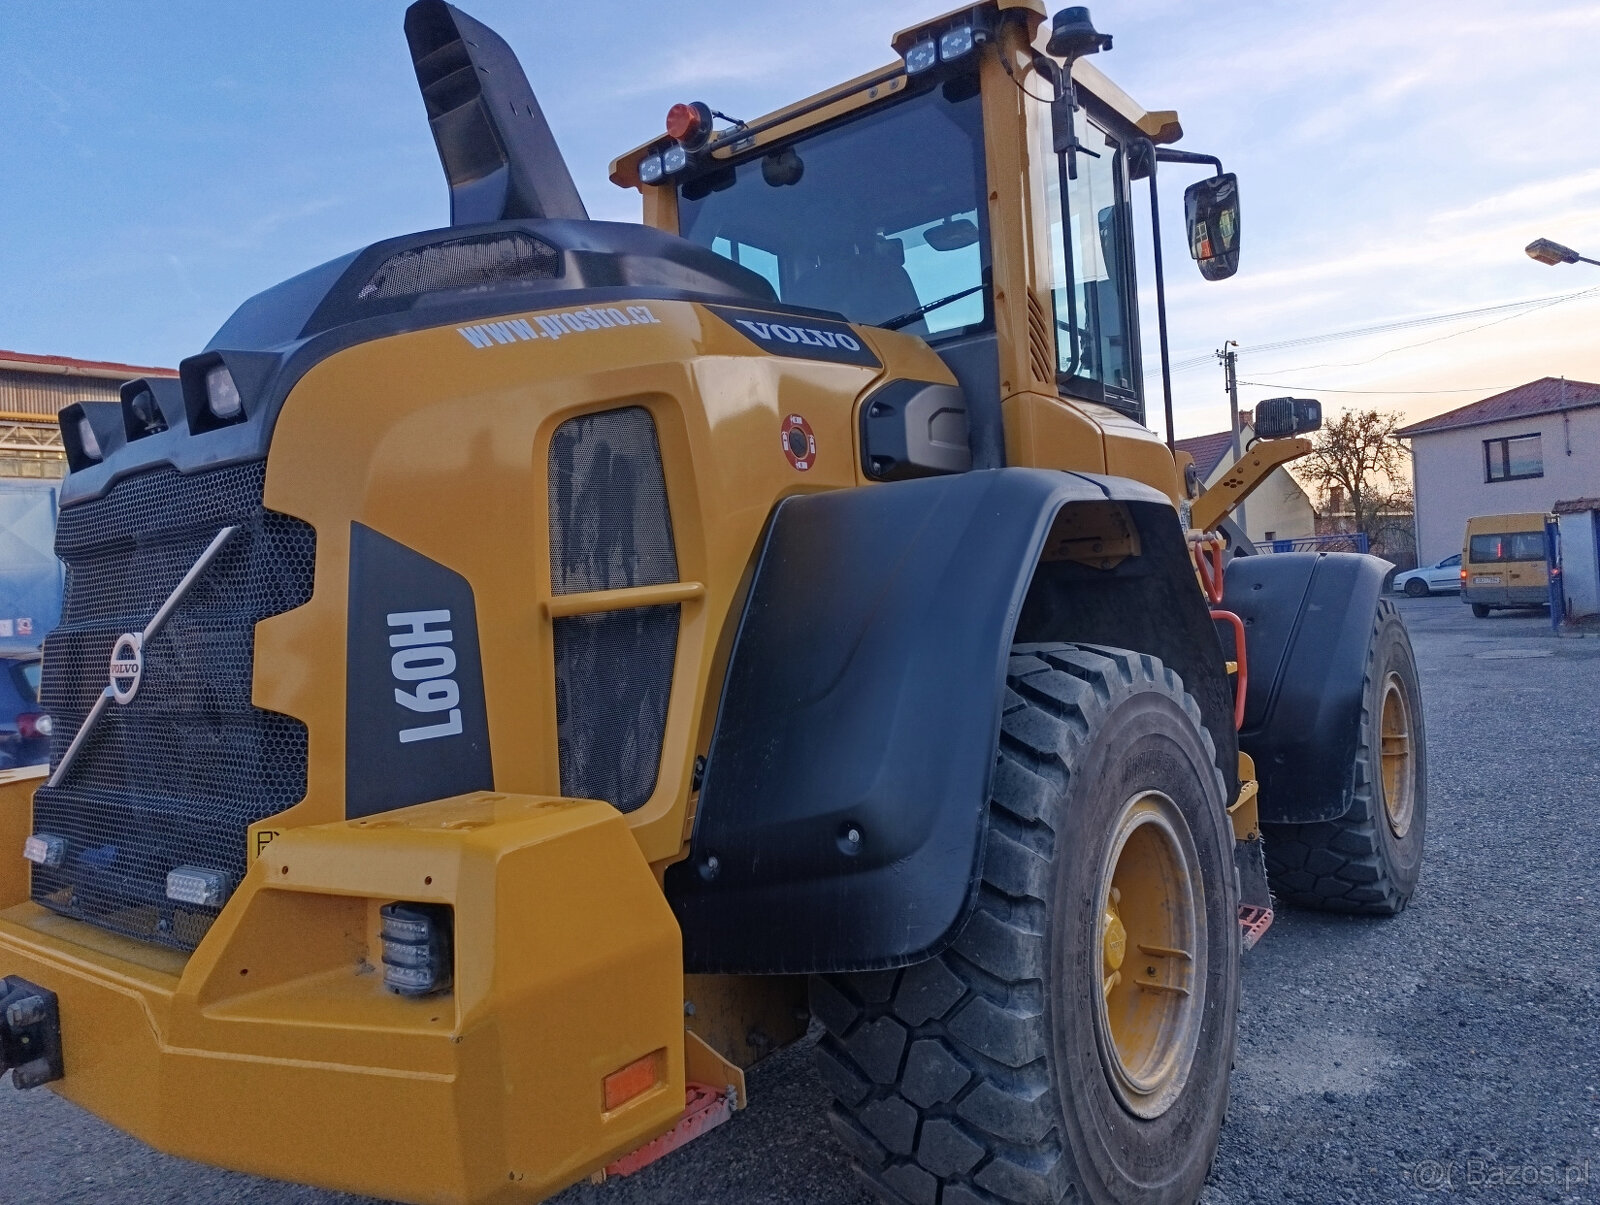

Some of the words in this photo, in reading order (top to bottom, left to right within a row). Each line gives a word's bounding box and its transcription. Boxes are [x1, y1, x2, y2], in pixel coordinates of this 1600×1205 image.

[457, 305, 661, 349] www.prostro.cz
[736, 319, 861, 351] VOLVO
[111, 663, 139, 674] VOLVO
[387, 609, 463, 743] L60H
